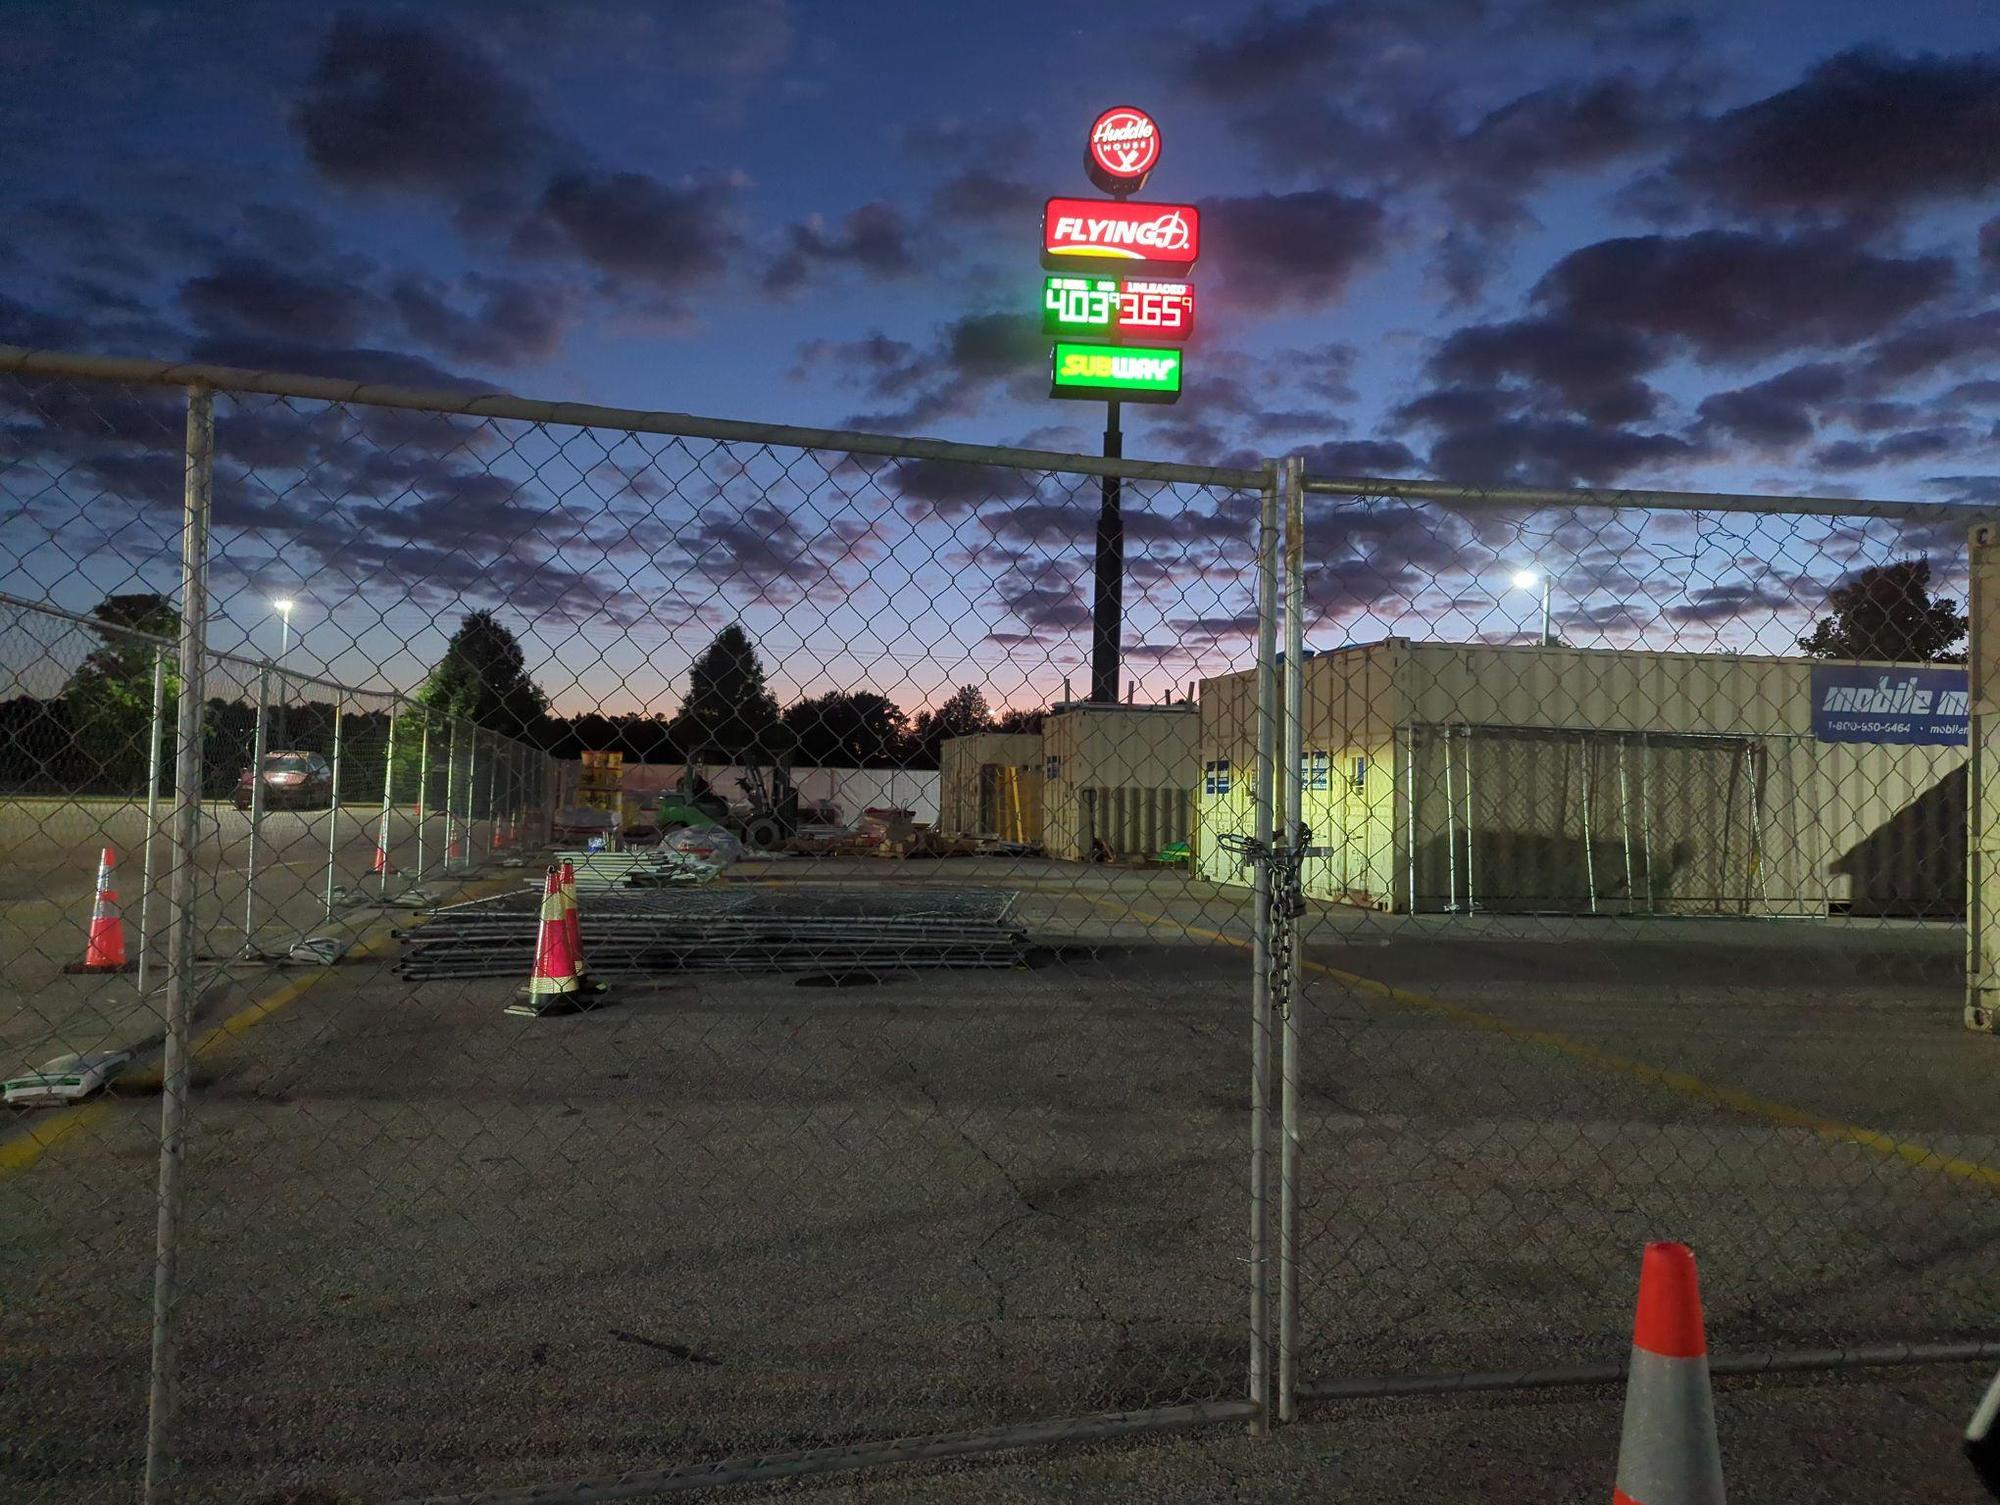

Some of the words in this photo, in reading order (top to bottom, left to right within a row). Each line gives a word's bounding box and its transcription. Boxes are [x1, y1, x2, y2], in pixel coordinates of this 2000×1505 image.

[1093, 118, 1153, 143] Huddle
[1104, 141, 1146, 152] HOUSE
[1054, 217, 1157, 245] FLYING
[1127, 282, 1188, 295] UNLEADED
[1060, 354, 1176, 381] SUBWAY
[1822, 676, 1933, 715] mobile
